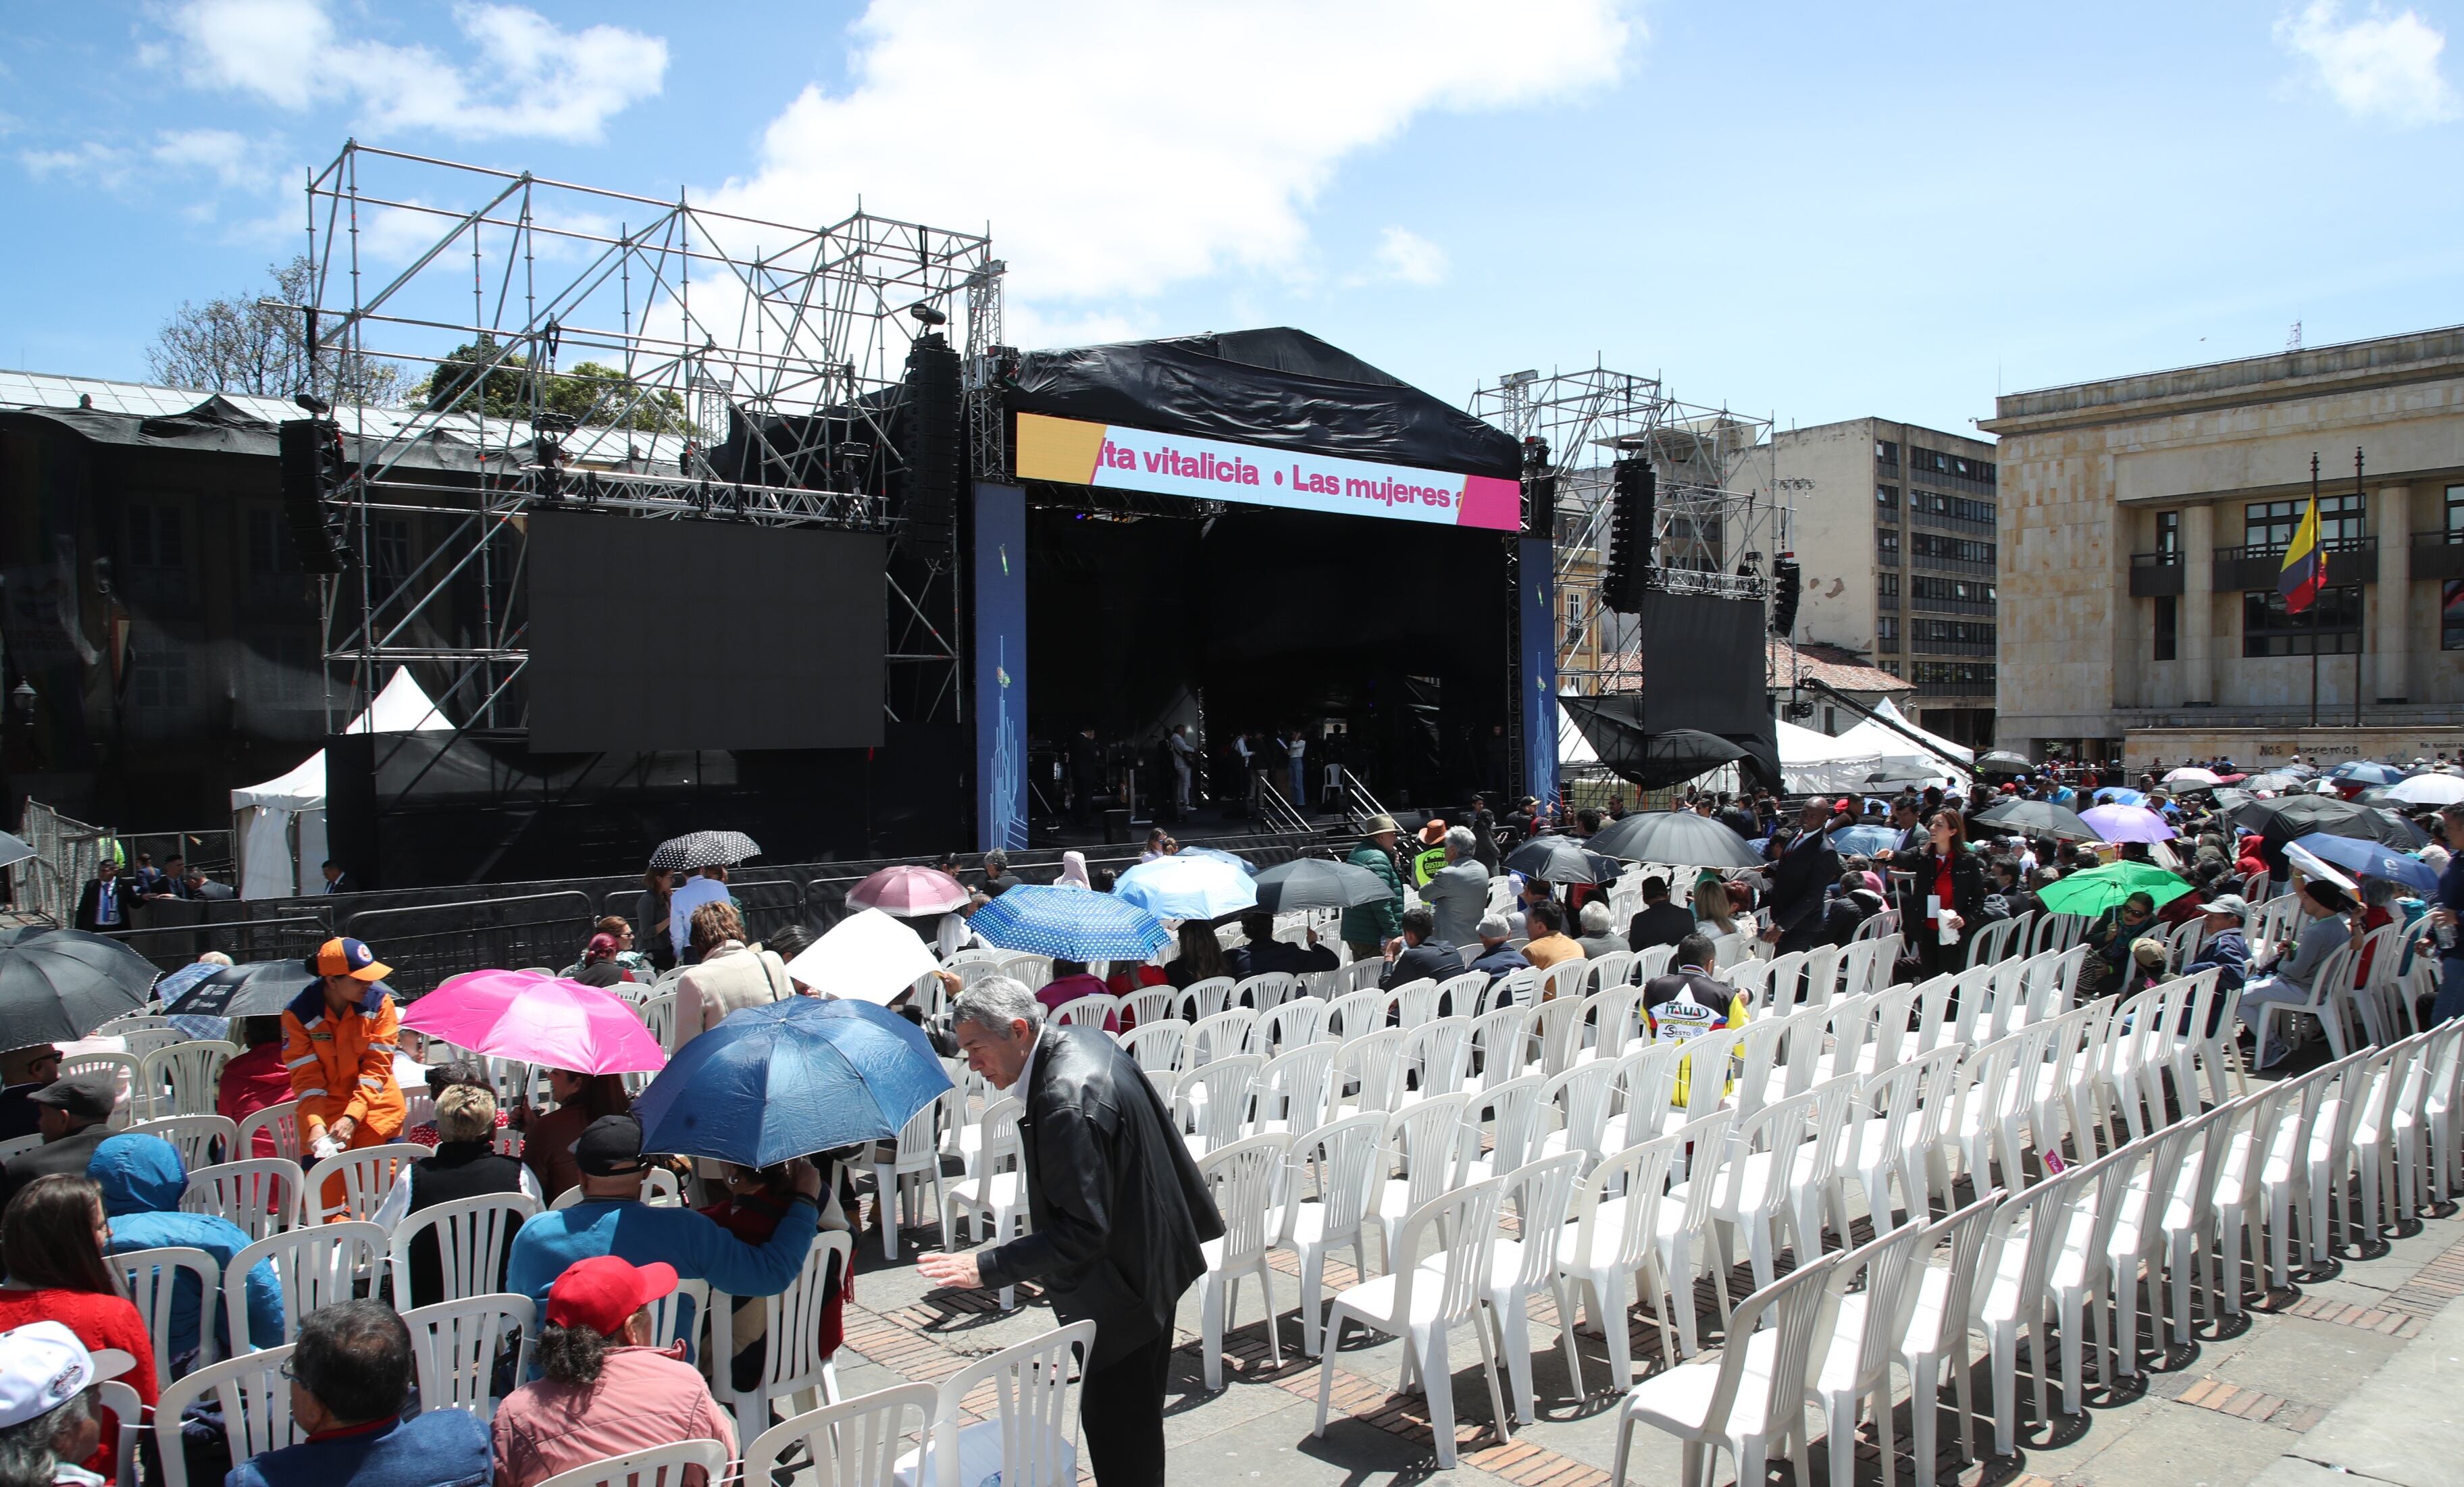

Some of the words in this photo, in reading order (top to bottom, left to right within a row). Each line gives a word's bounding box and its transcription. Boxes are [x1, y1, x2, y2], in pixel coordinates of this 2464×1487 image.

[1143, 446, 1260, 486] vitalicia
[1293, 464, 1340, 496] Las
[1345, 476, 1451, 508] mujeres
[1666, 1006, 1701, 1016] ITALIA
